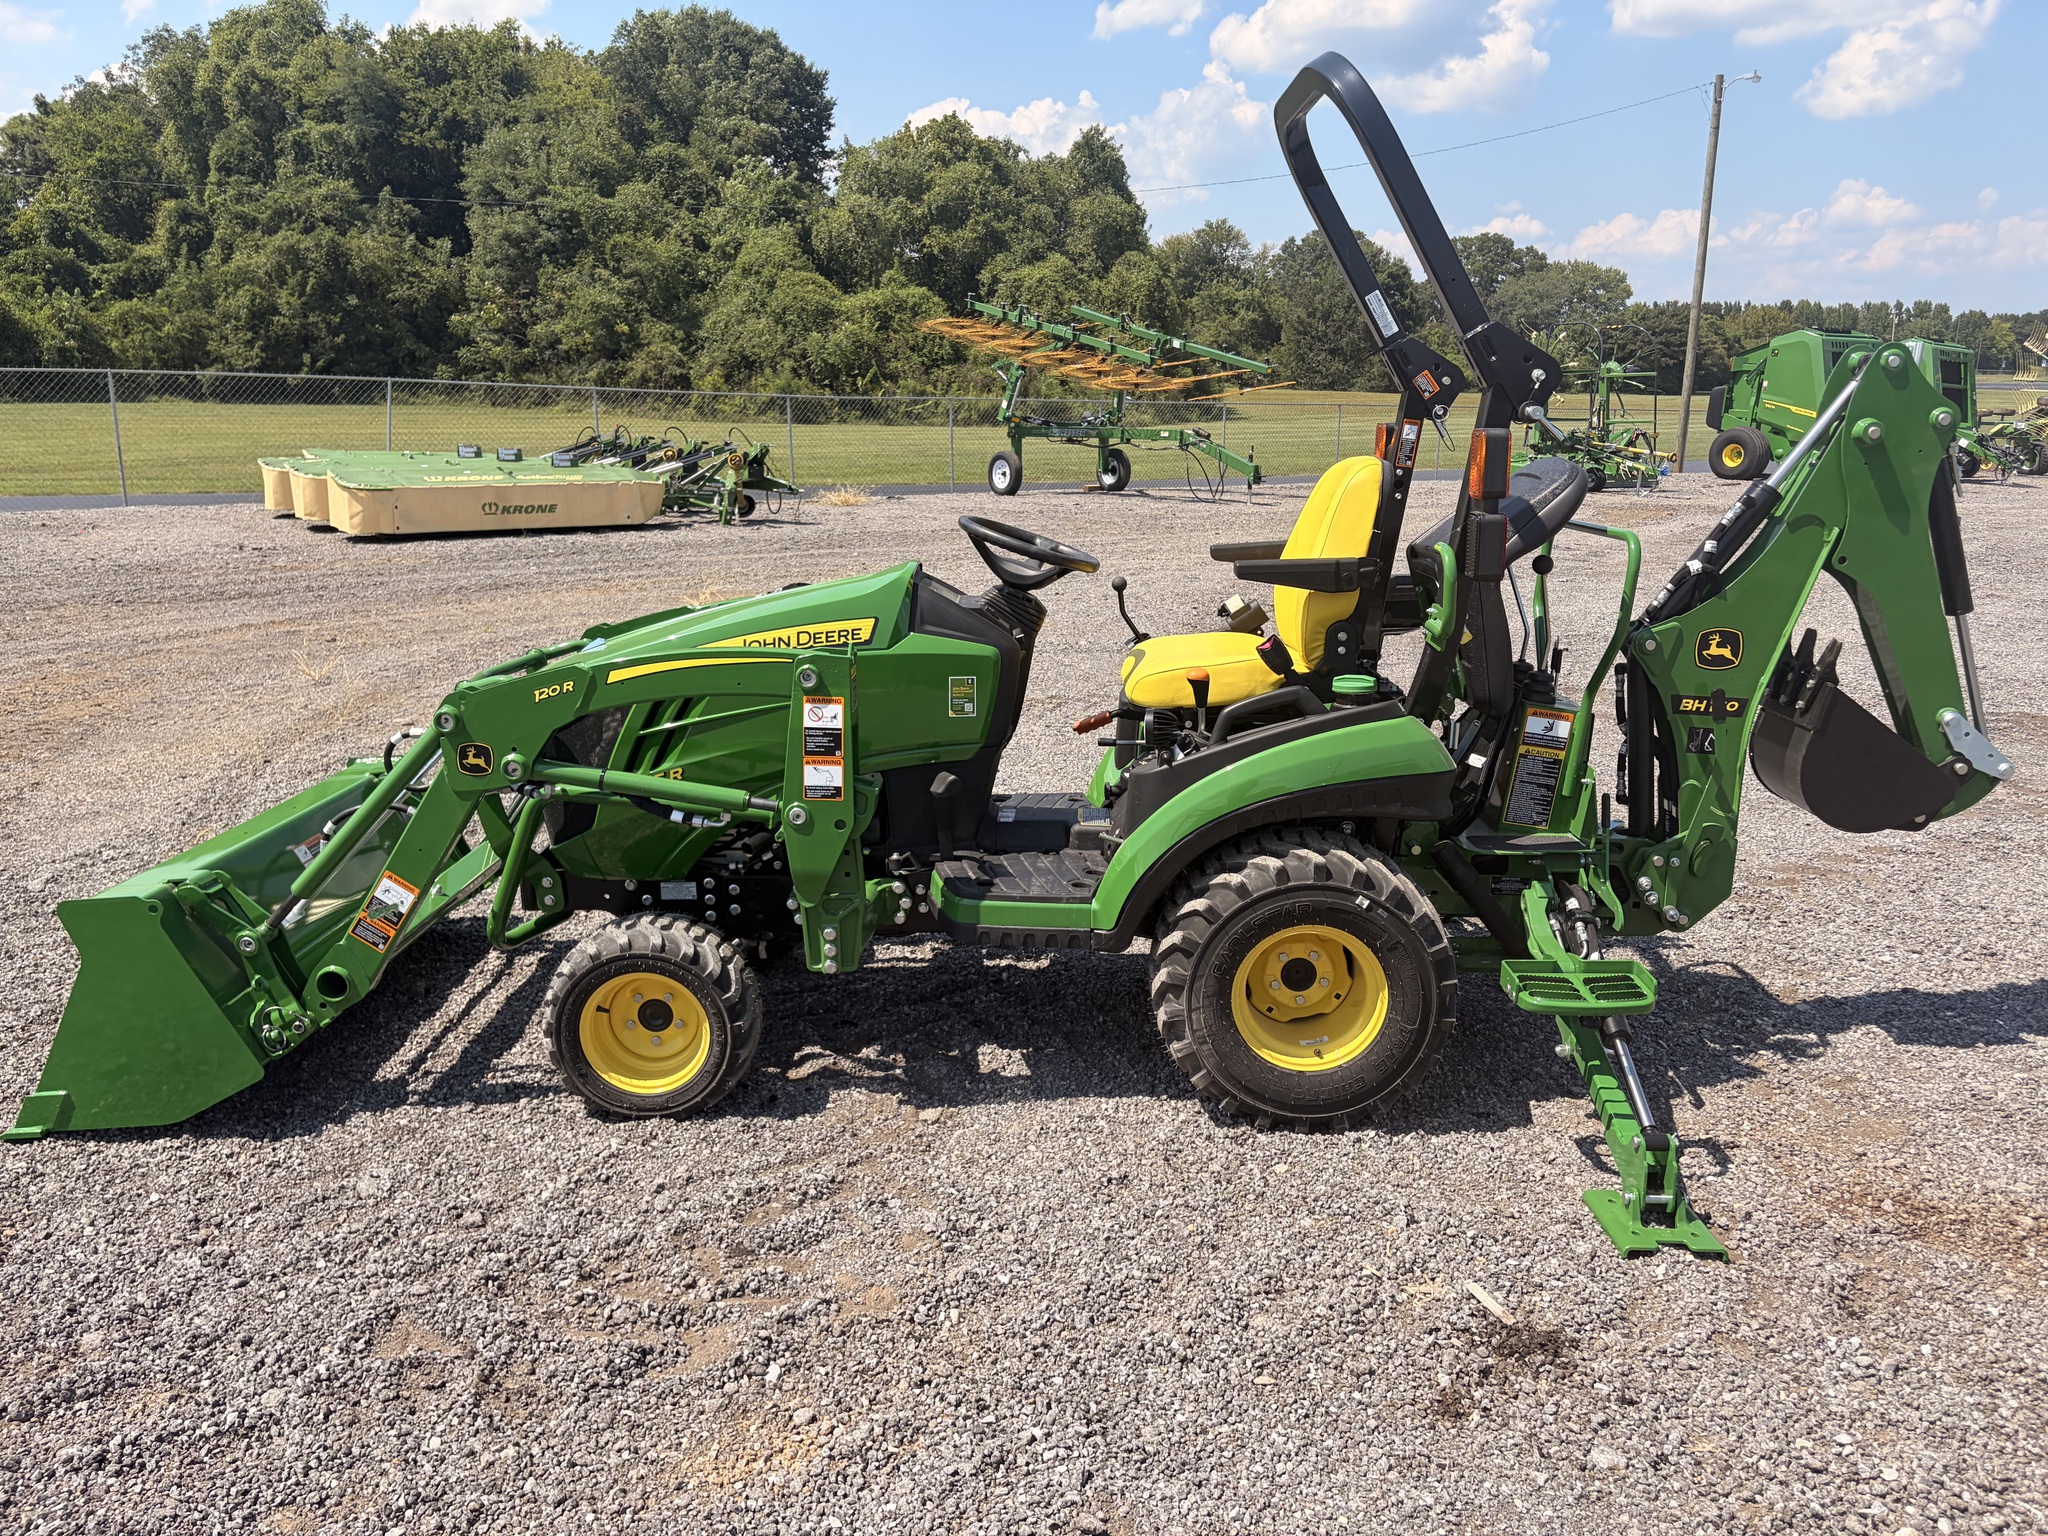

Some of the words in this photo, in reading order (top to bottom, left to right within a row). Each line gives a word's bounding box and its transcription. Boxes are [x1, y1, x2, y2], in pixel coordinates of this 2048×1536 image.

[500, 503, 558, 516] KRONE
[743, 635, 791, 648] JOHN
[797, 628, 863, 646] DEERE
[534, 685, 561, 703] 120
[563, 681, 575, 694] R
[1679, 698, 1708, 712] BH
[1539, 711, 1570, 721] WARNING
[1531, 748, 1560, 759] CAUTION
[811, 758, 842, 766] WARNING
[393, 877, 416, 894] WARNING
[1211, 902, 1313, 977] CARLSTAR
